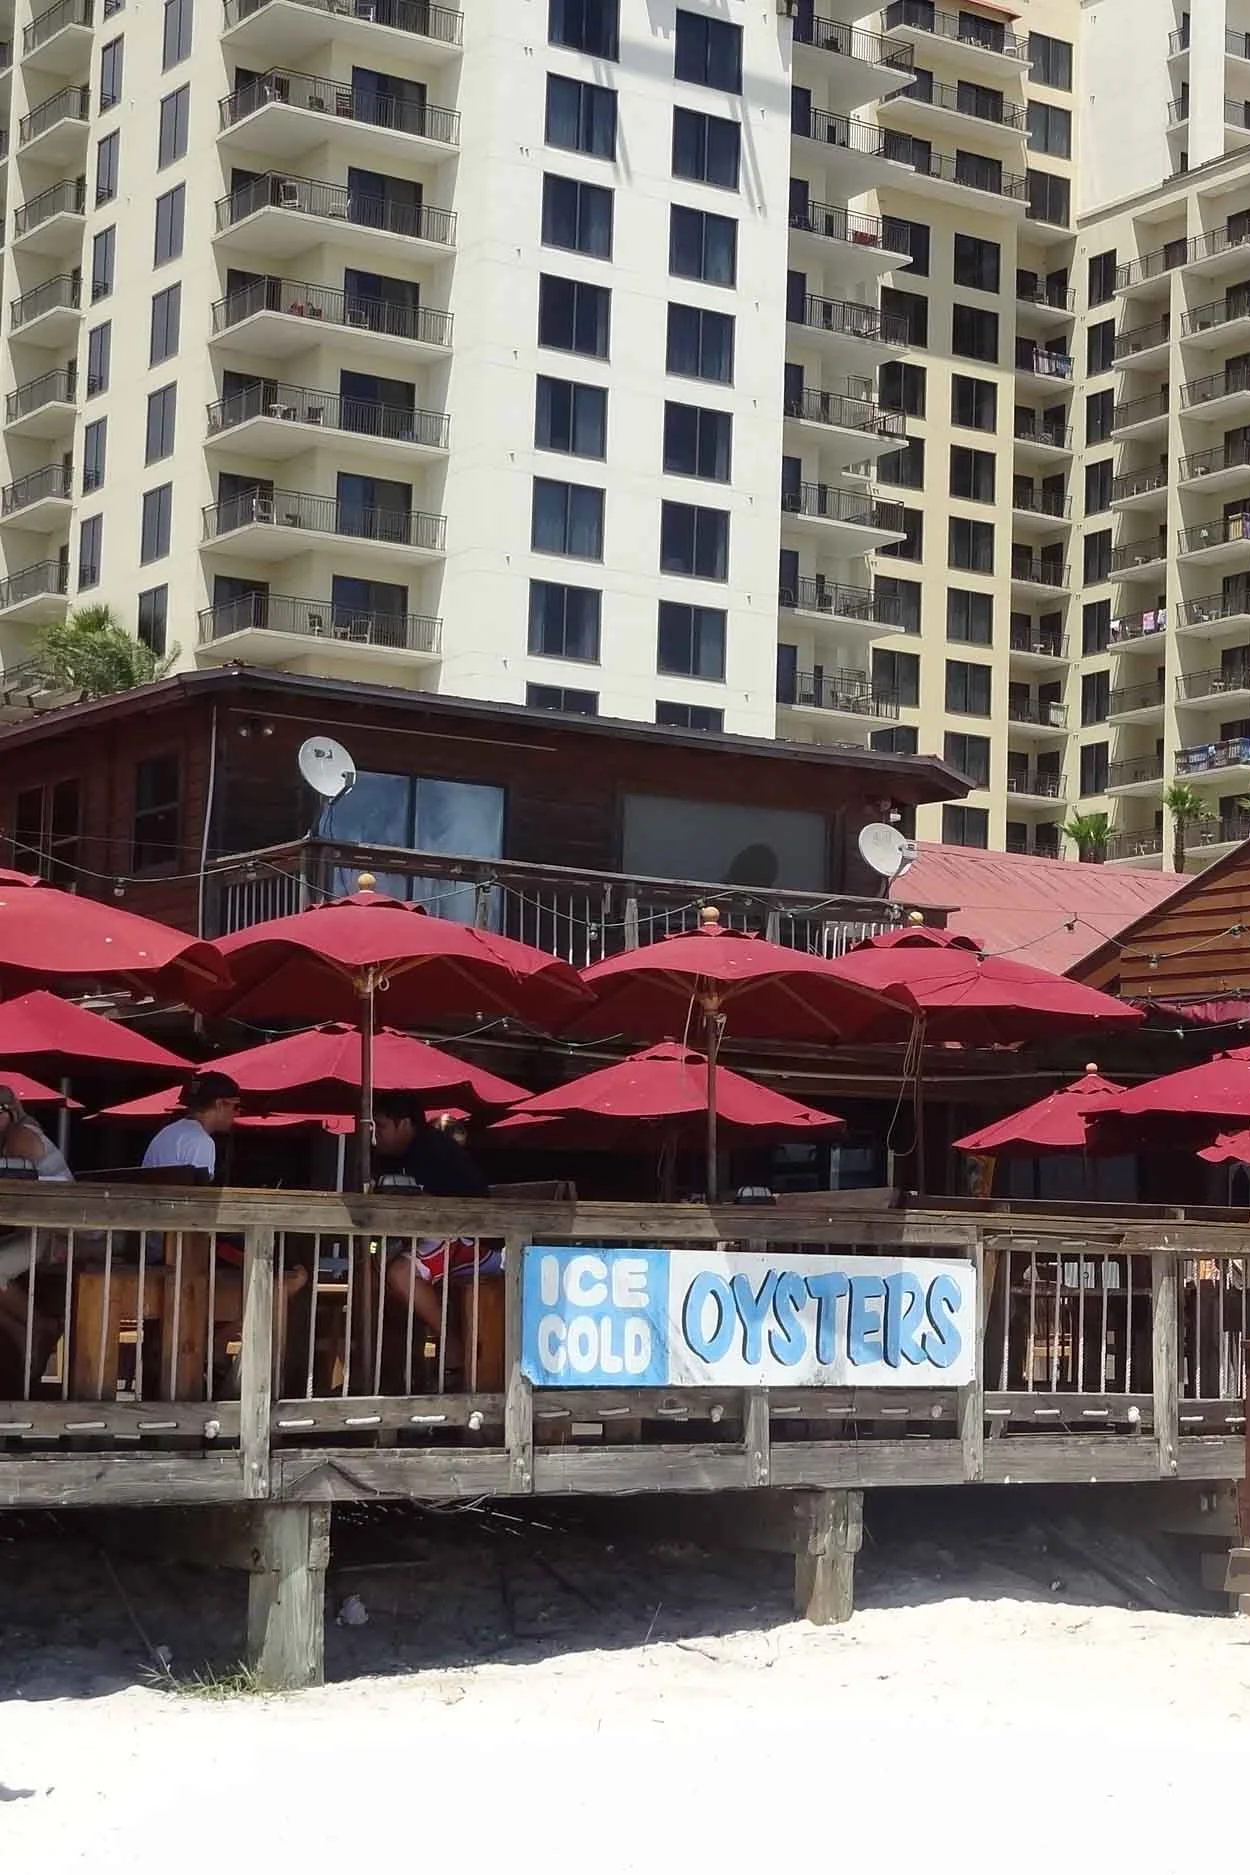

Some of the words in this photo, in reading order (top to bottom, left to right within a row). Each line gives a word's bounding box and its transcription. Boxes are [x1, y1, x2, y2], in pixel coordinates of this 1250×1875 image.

[540, 1254, 650, 1308] ICE
[538, 1314, 652, 1374] COLD
[682, 1269, 963, 1369] OYSTERS
